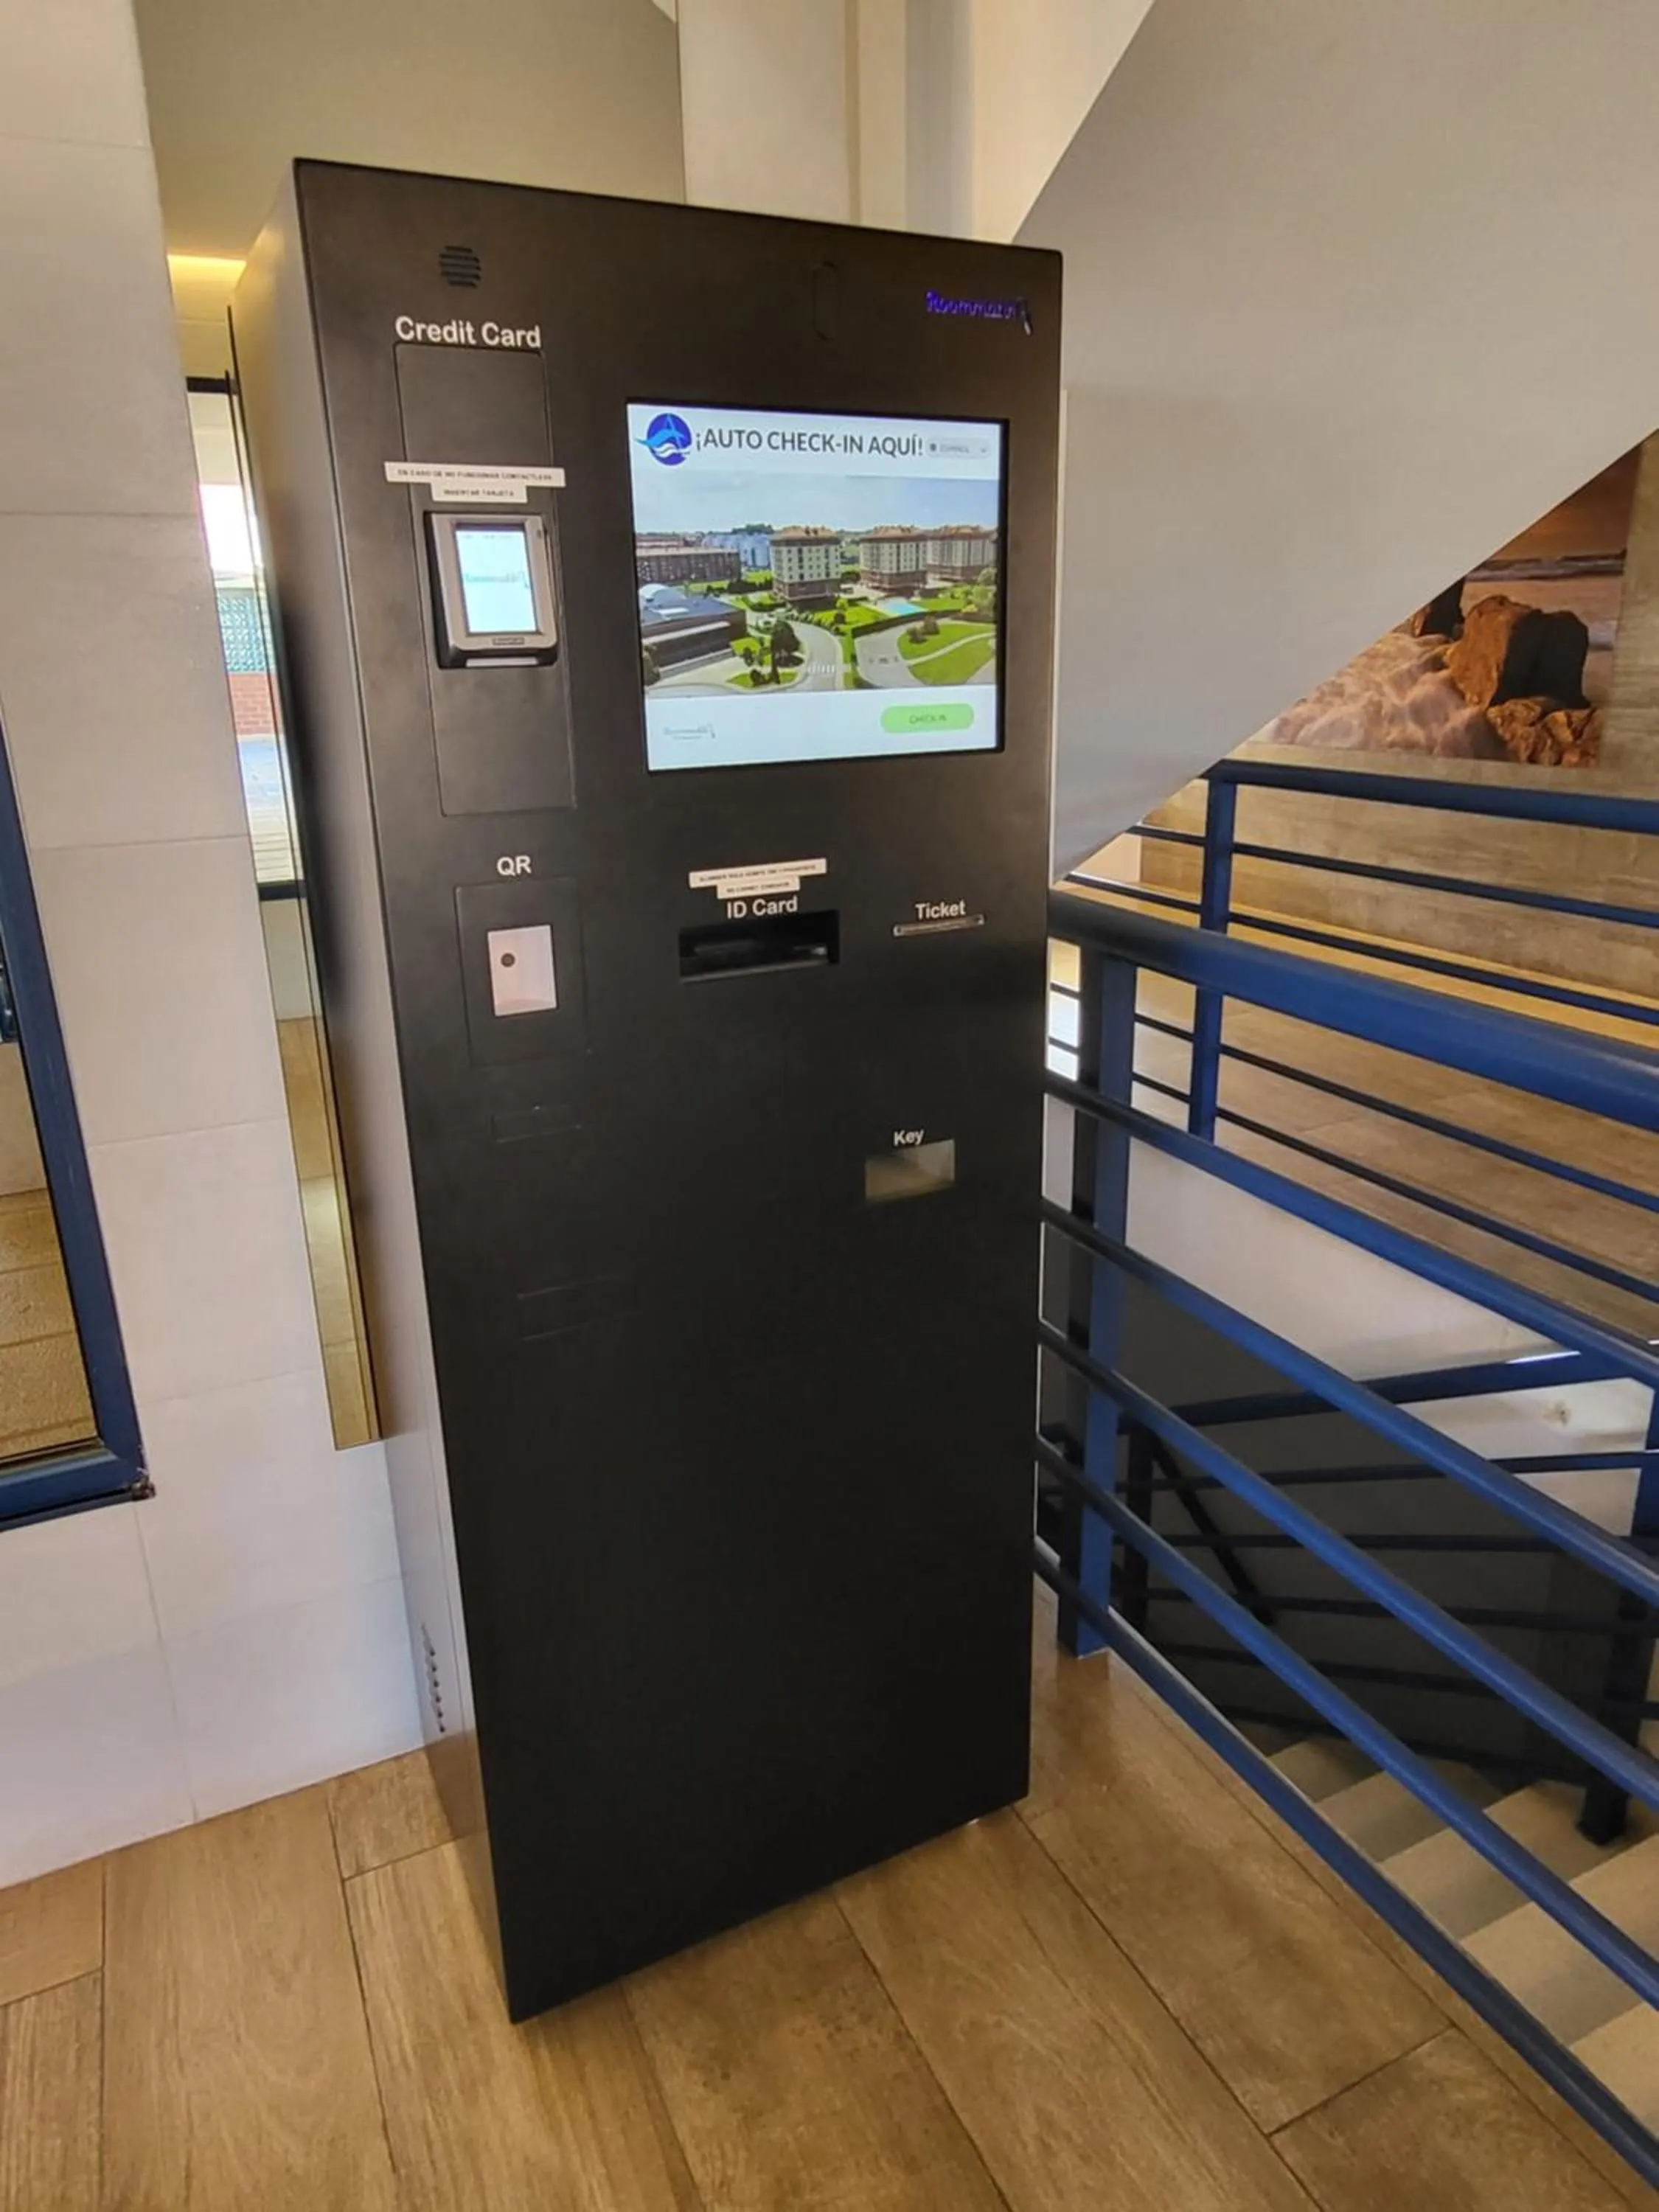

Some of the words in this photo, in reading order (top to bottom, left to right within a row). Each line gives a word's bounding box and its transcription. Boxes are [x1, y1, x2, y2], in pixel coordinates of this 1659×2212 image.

[395, 316, 476, 345] Credit
[481, 321, 542, 348] Card
[696, 428, 762, 452] ¡AUTO
[768, 431, 863, 454] CHECK-IN
[868, 434, 923, 459] AQUÍ!
[497, 855, 532, 877] QR
[726, 901, 747, 919] ID
[752, 895, 798, 916] Card
[915, 899, 966, 920] Ticket
[894, 1130, 925, 1147] Key
